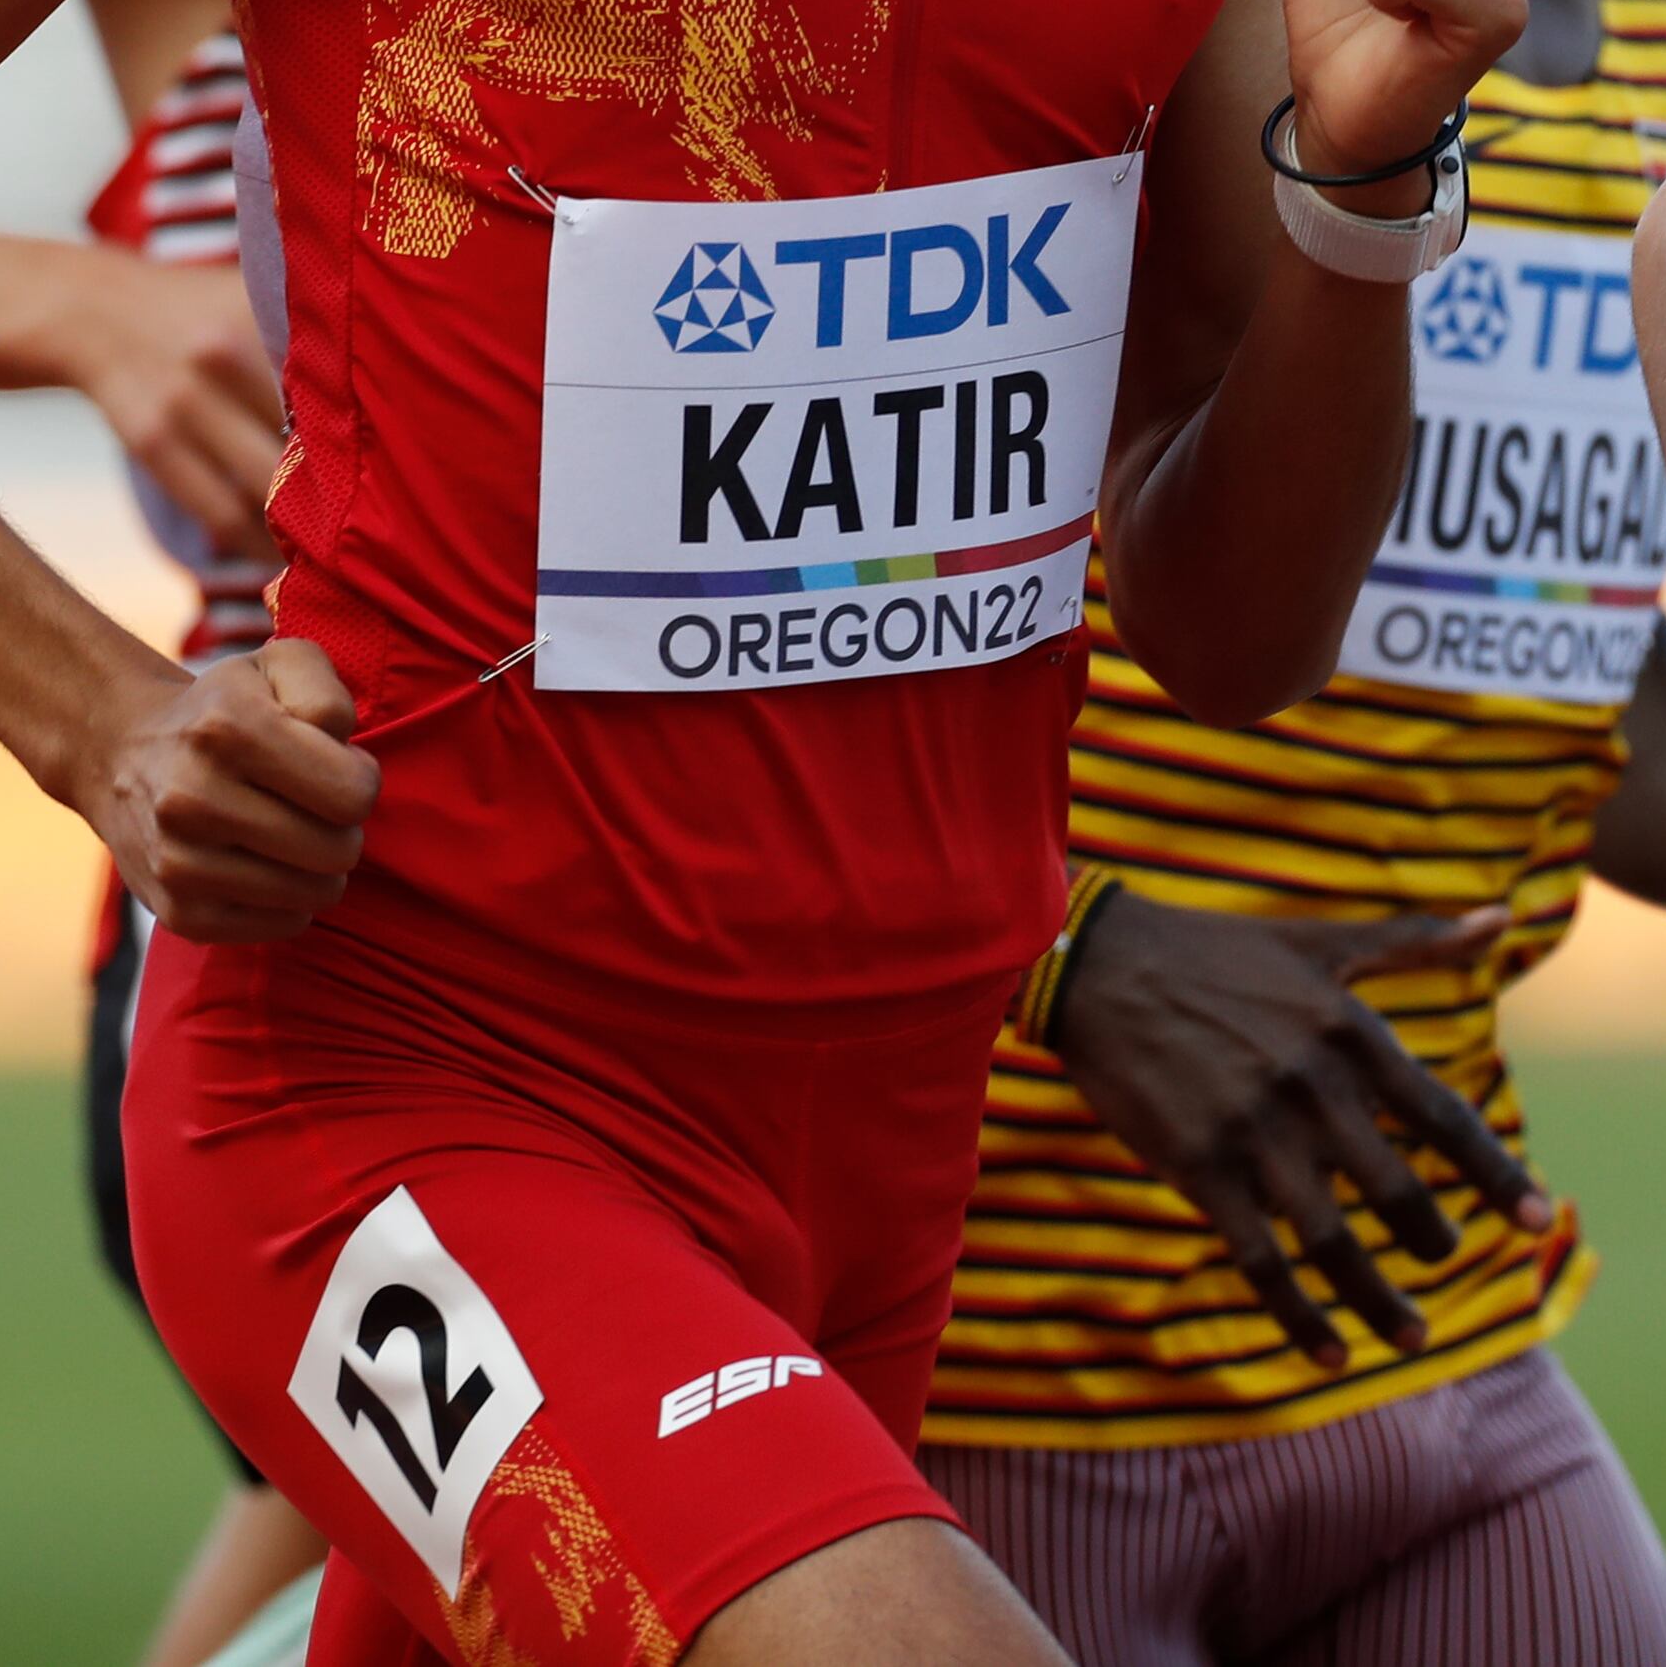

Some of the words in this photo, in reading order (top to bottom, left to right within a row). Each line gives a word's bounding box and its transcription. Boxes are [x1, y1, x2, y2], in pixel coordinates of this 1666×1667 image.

[775, 200, 1073, 348] TDK
[1517, 265, 1636, 374] TD
[678, 370, 1050, 544] KATIR
[658, 575, 1044, 680] OREGON22
[336, 1282, 495, 1517] 12
[657, 1355, 823, 1439] ESP
